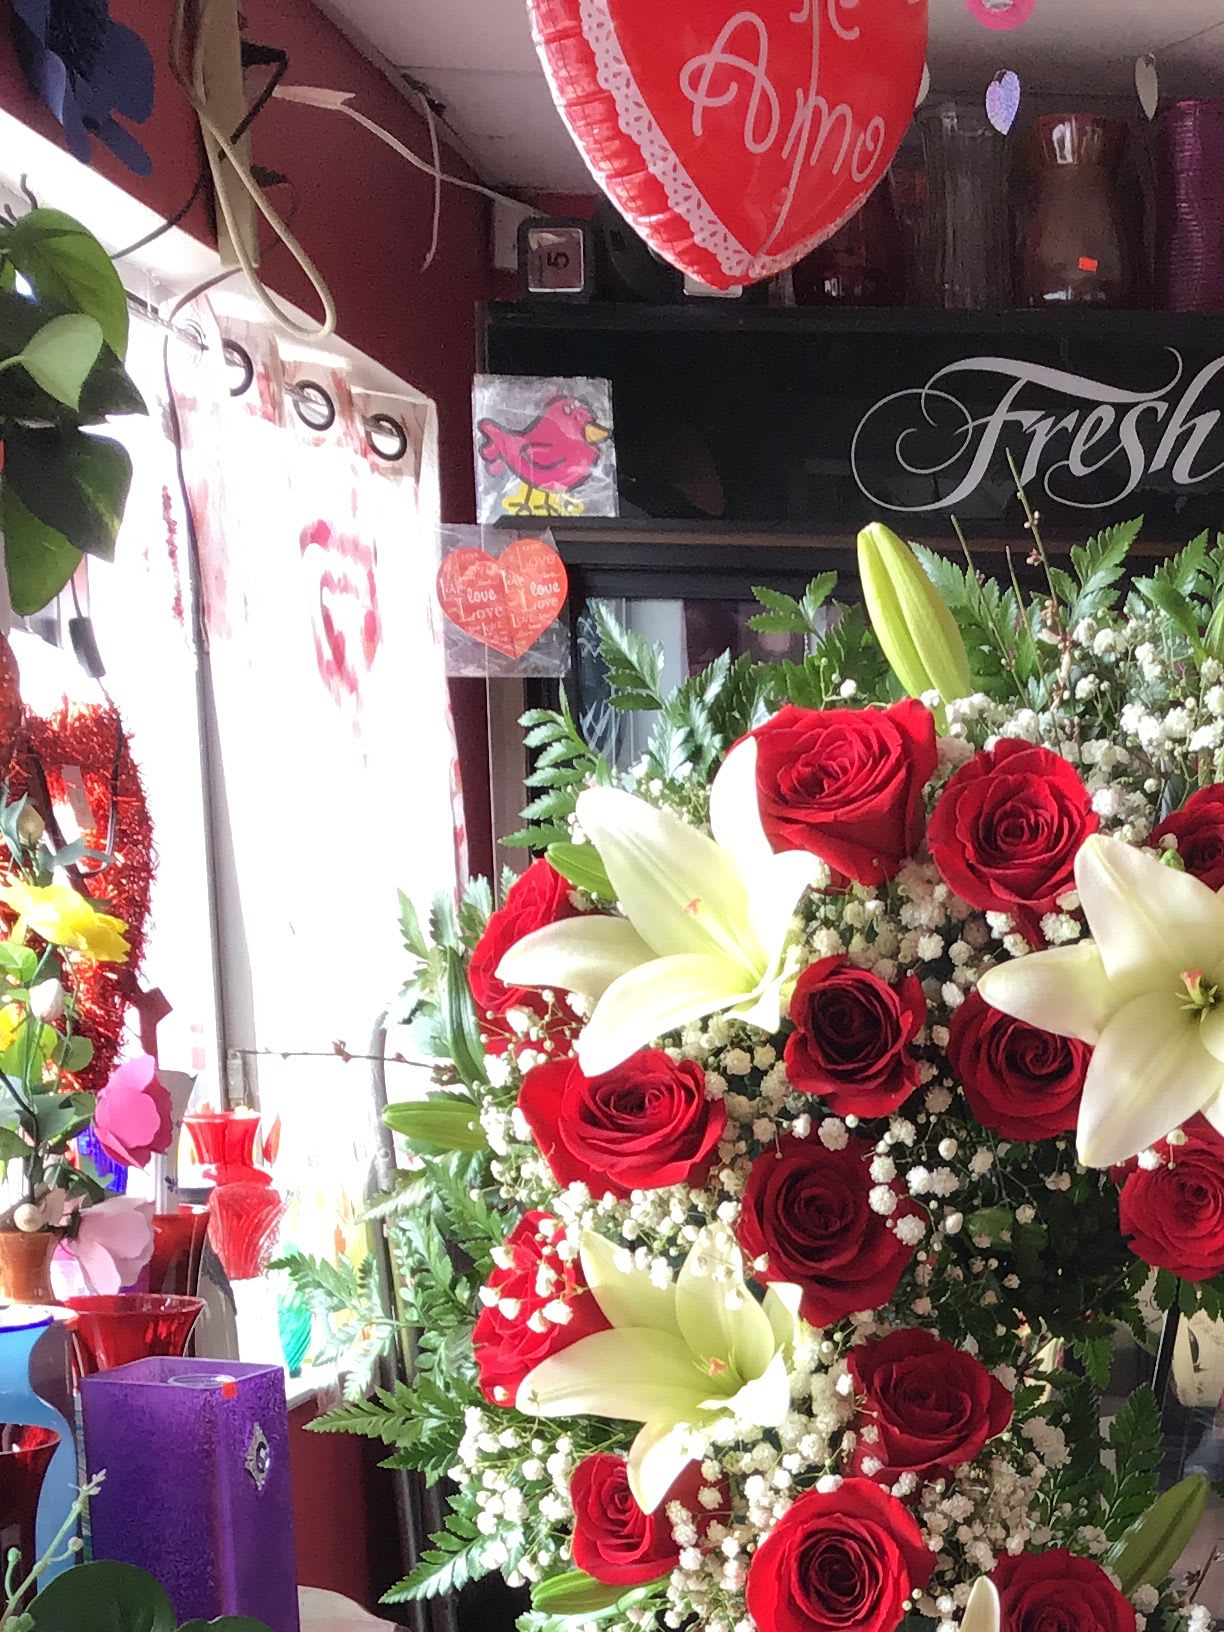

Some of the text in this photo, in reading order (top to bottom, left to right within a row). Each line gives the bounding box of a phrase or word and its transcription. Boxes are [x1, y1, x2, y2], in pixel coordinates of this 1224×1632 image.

[680, 11, 885, 184] Amo
[466, 587, 497, 604] love
[530, 581, 561, 597] love
